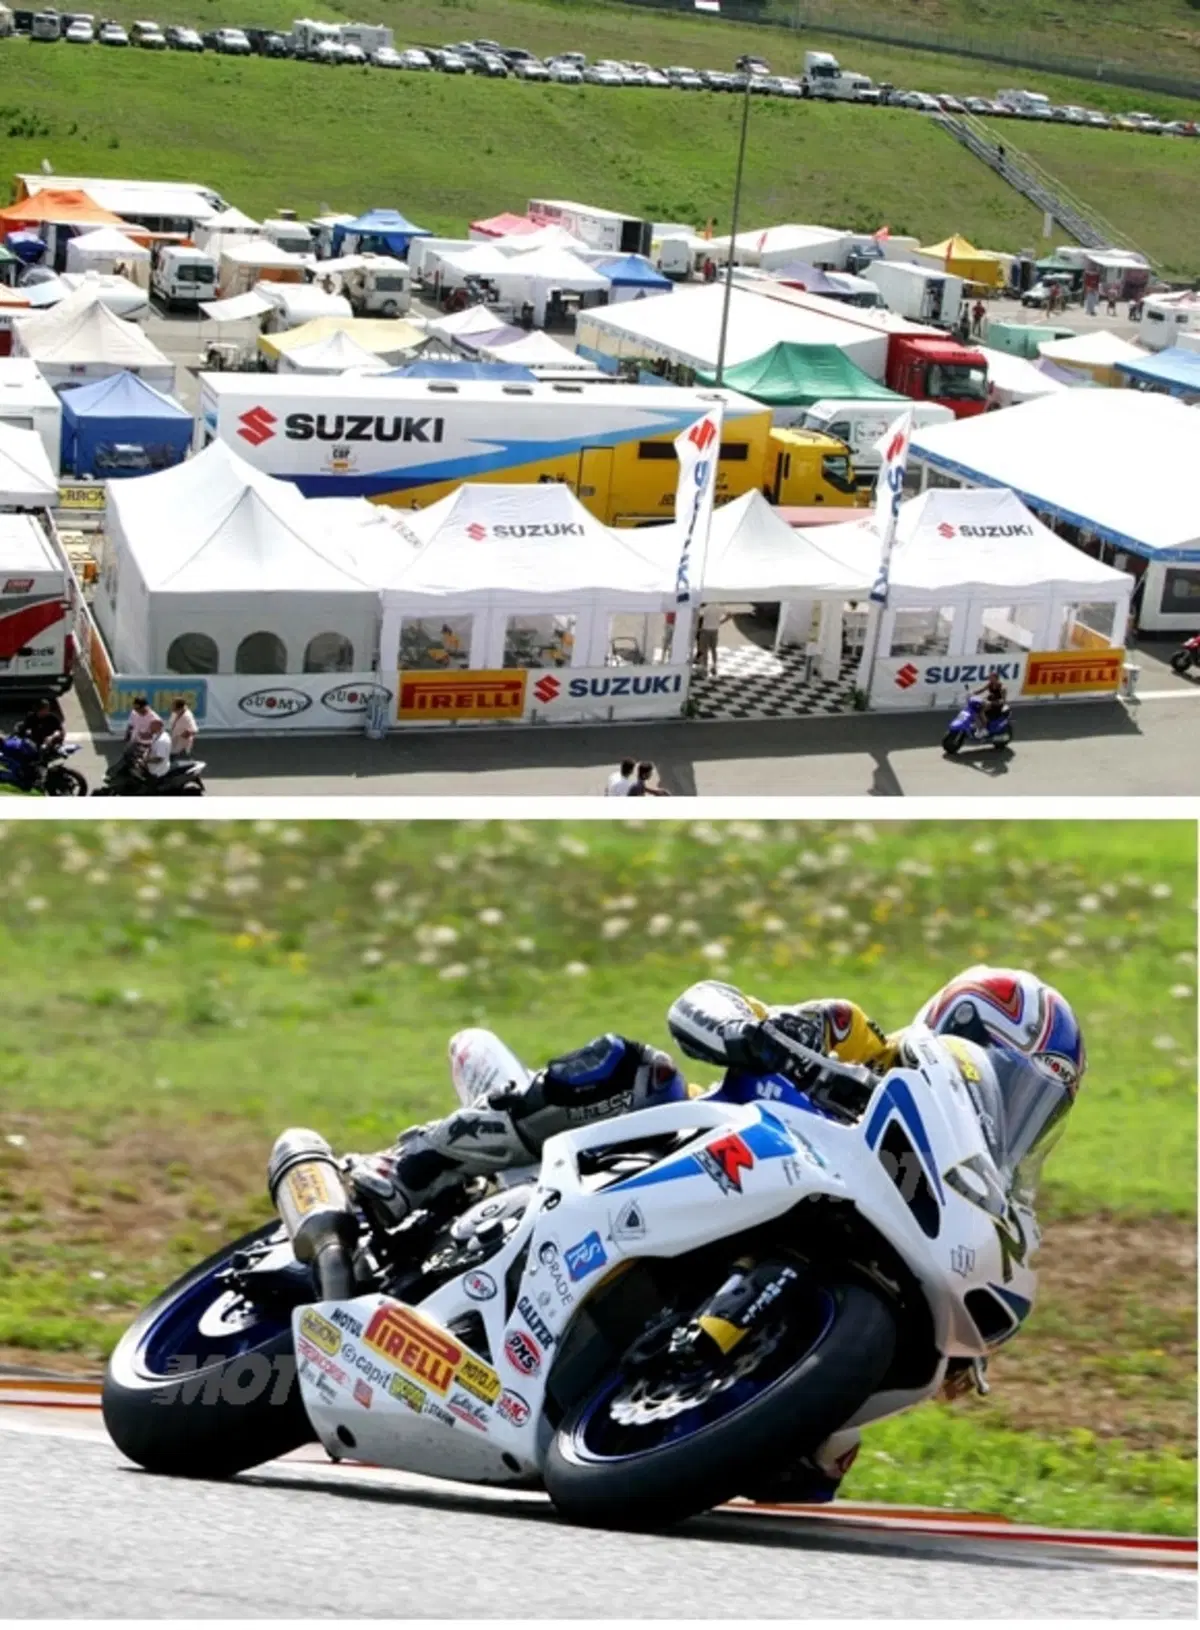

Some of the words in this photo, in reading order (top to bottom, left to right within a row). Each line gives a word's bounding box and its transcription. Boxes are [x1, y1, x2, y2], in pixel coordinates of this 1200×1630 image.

[285, 413, 444, 443] SUZUKI
[492, 523, 585, 539] SUZUKI
[959, 524, 1033, 538] SUZUKI
[569, 674, 681, 698] SUZUKI
[925, 663, 1019, 684] SUZUKI
[1028, 658, 1120, 685] PIRELLI
[401, 680, 522, 709] PIRELLI
[331, 1308, 363, 1338] MOTUL
[518, 1296, 553, 1349] GALFER
[365, 1306, 462, 1391] PIRELLI
[508, 1333, 540, 1372] PMS
[355, 1356, 392, 1390] capit
